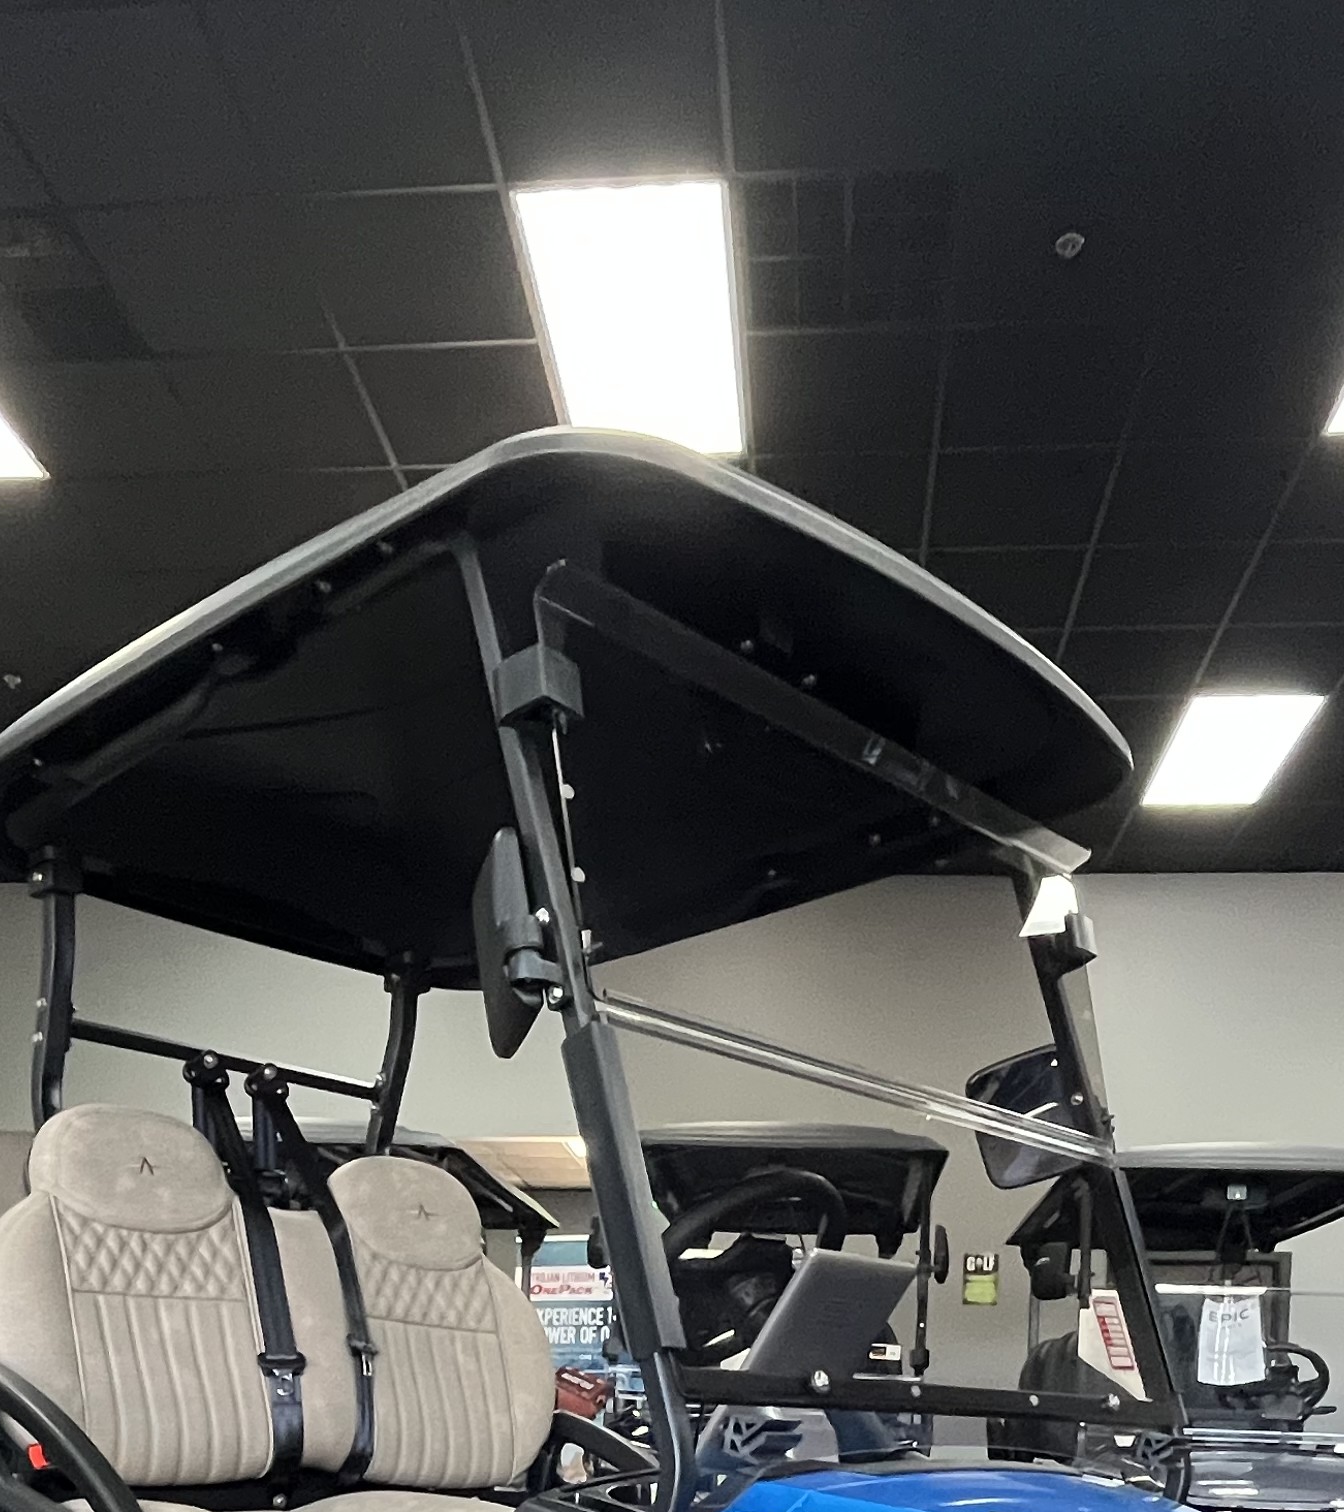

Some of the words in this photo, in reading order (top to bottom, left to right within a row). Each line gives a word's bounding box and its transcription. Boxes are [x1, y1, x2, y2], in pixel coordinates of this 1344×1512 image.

[536, 1306, 605, 1326] XPERIENCE
[1209, 1308, 1250, 1323] EPIC
[579, 1326, 597, 1344] OF
